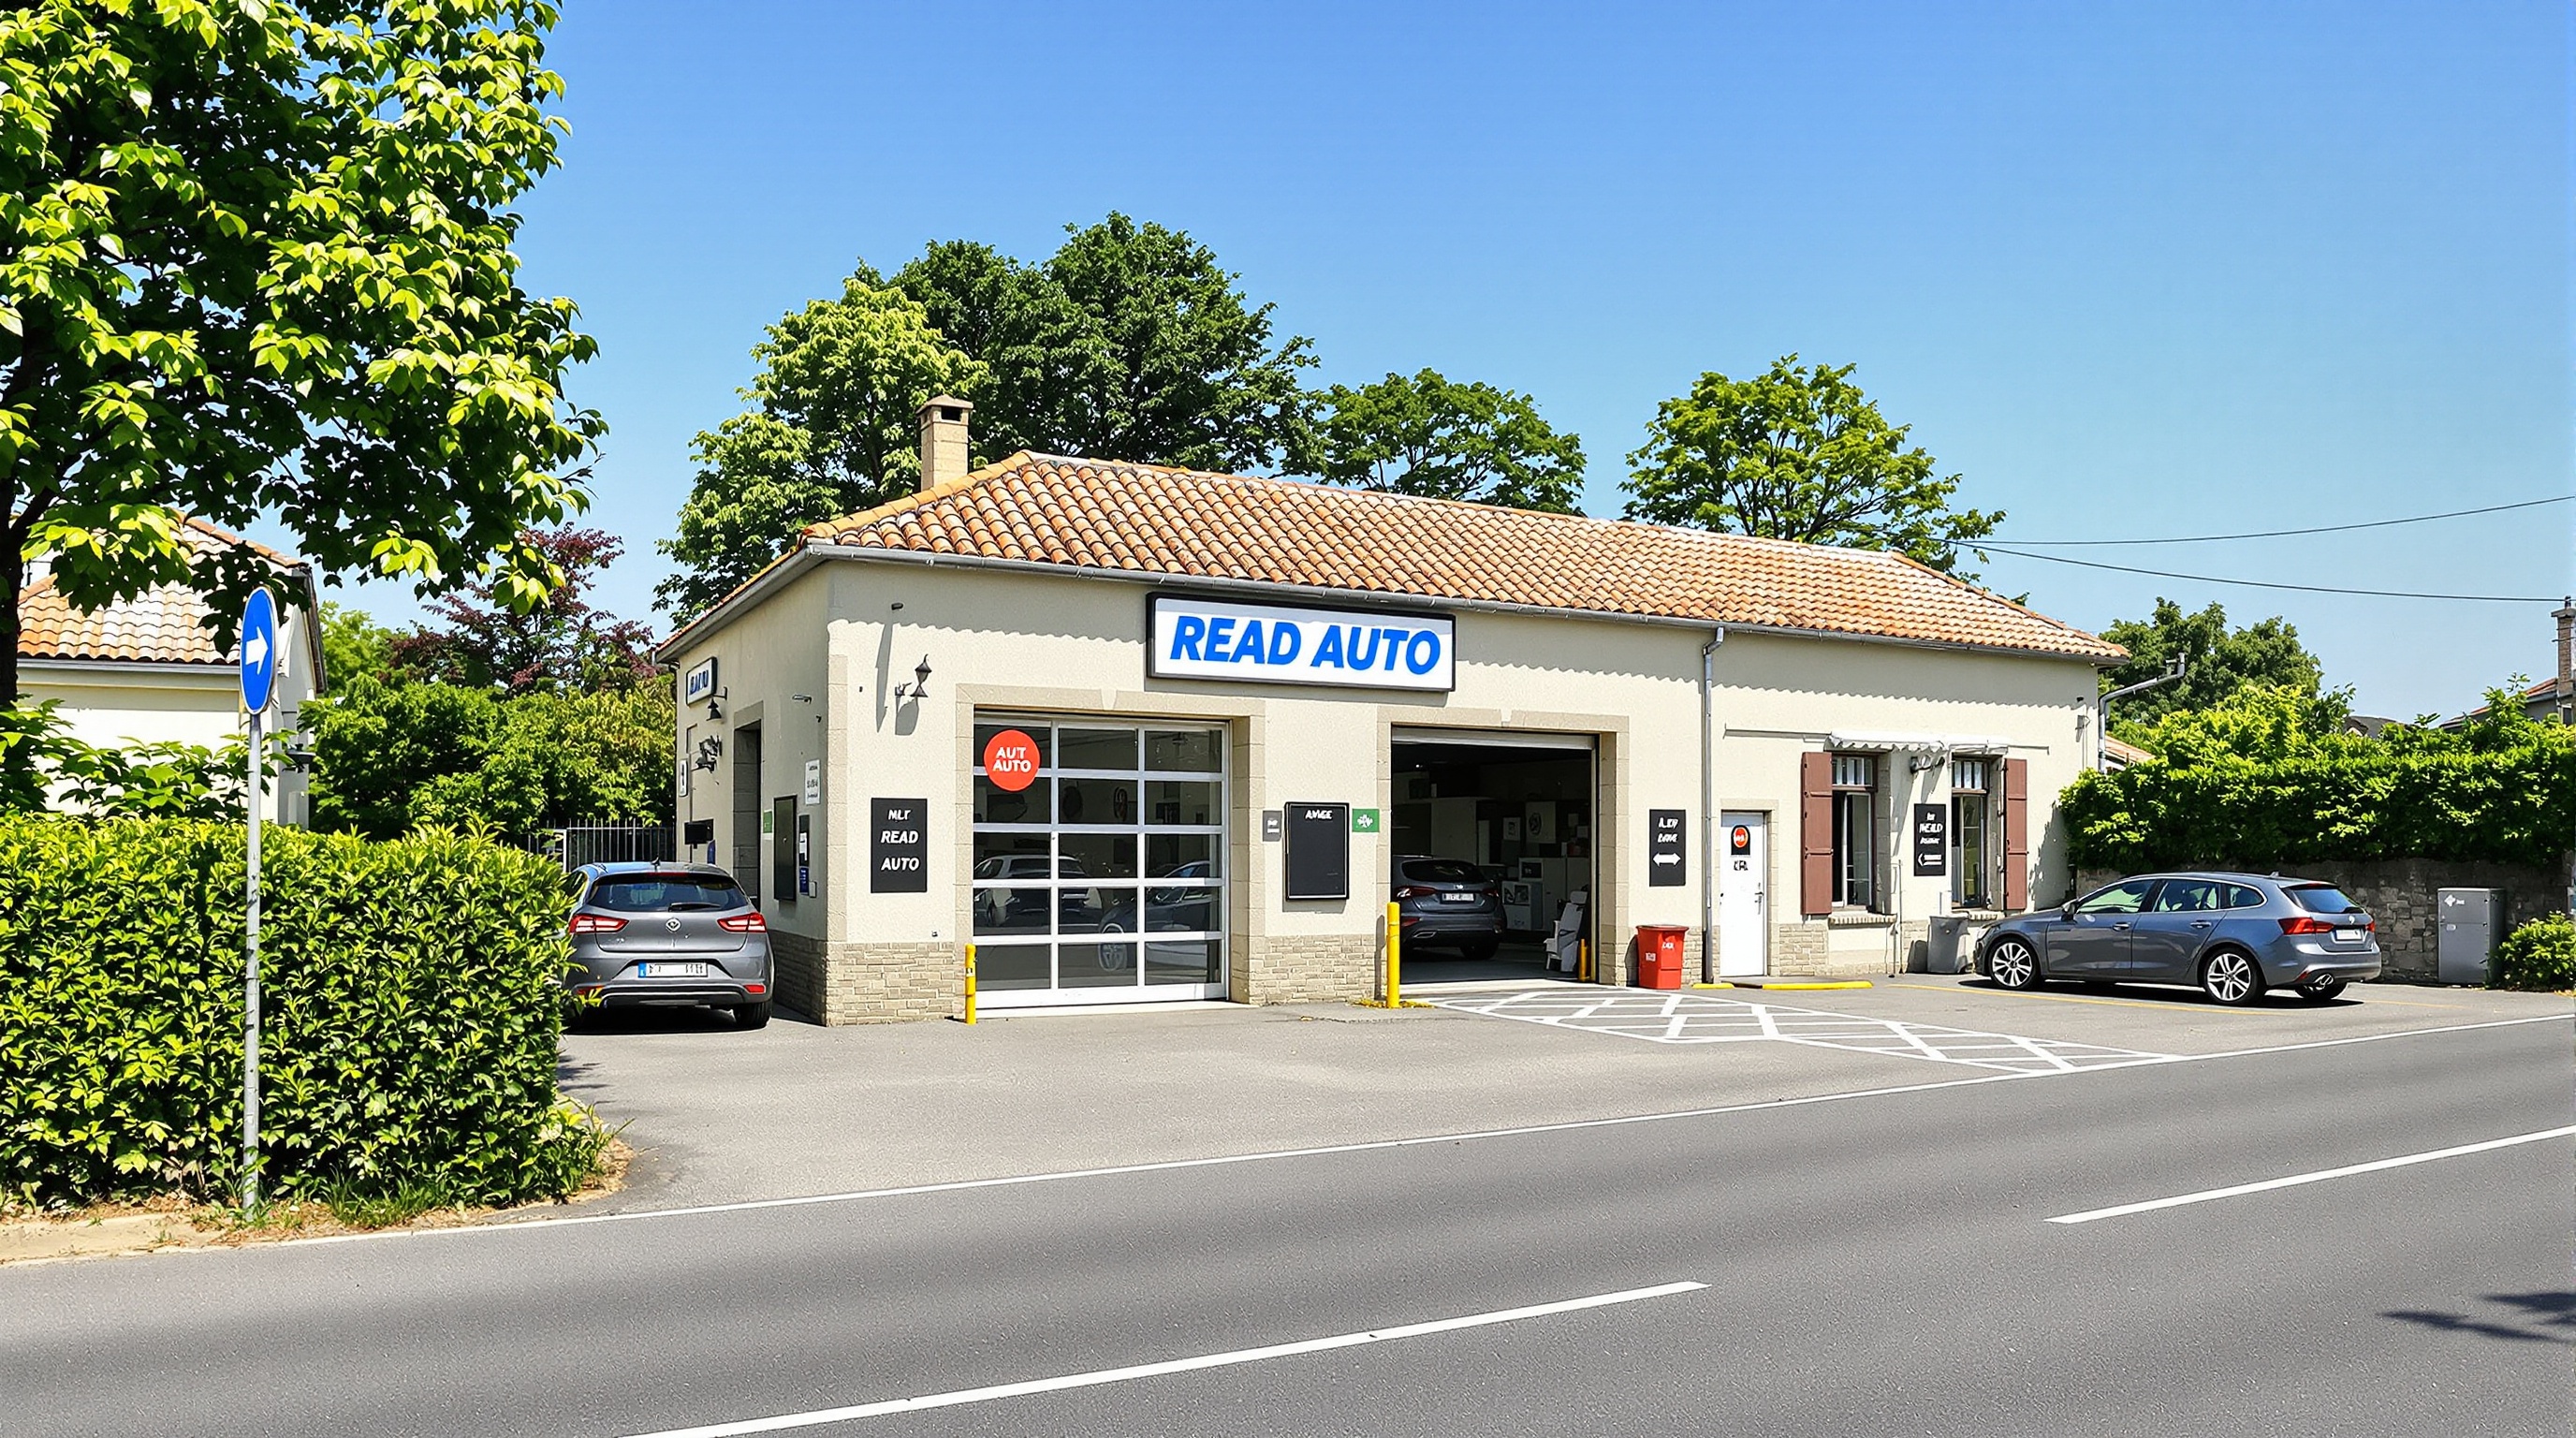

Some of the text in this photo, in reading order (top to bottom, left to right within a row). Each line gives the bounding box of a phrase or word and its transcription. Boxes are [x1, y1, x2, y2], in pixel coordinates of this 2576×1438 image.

[1170, 615, 1442, 676] READ AUTO
[995, 746, 1027, 759] AUT
[992, 759, 1032, 773] AUTO
[880, 830, 919, 844] READ
[880, 857, 920, 872] AUTO
